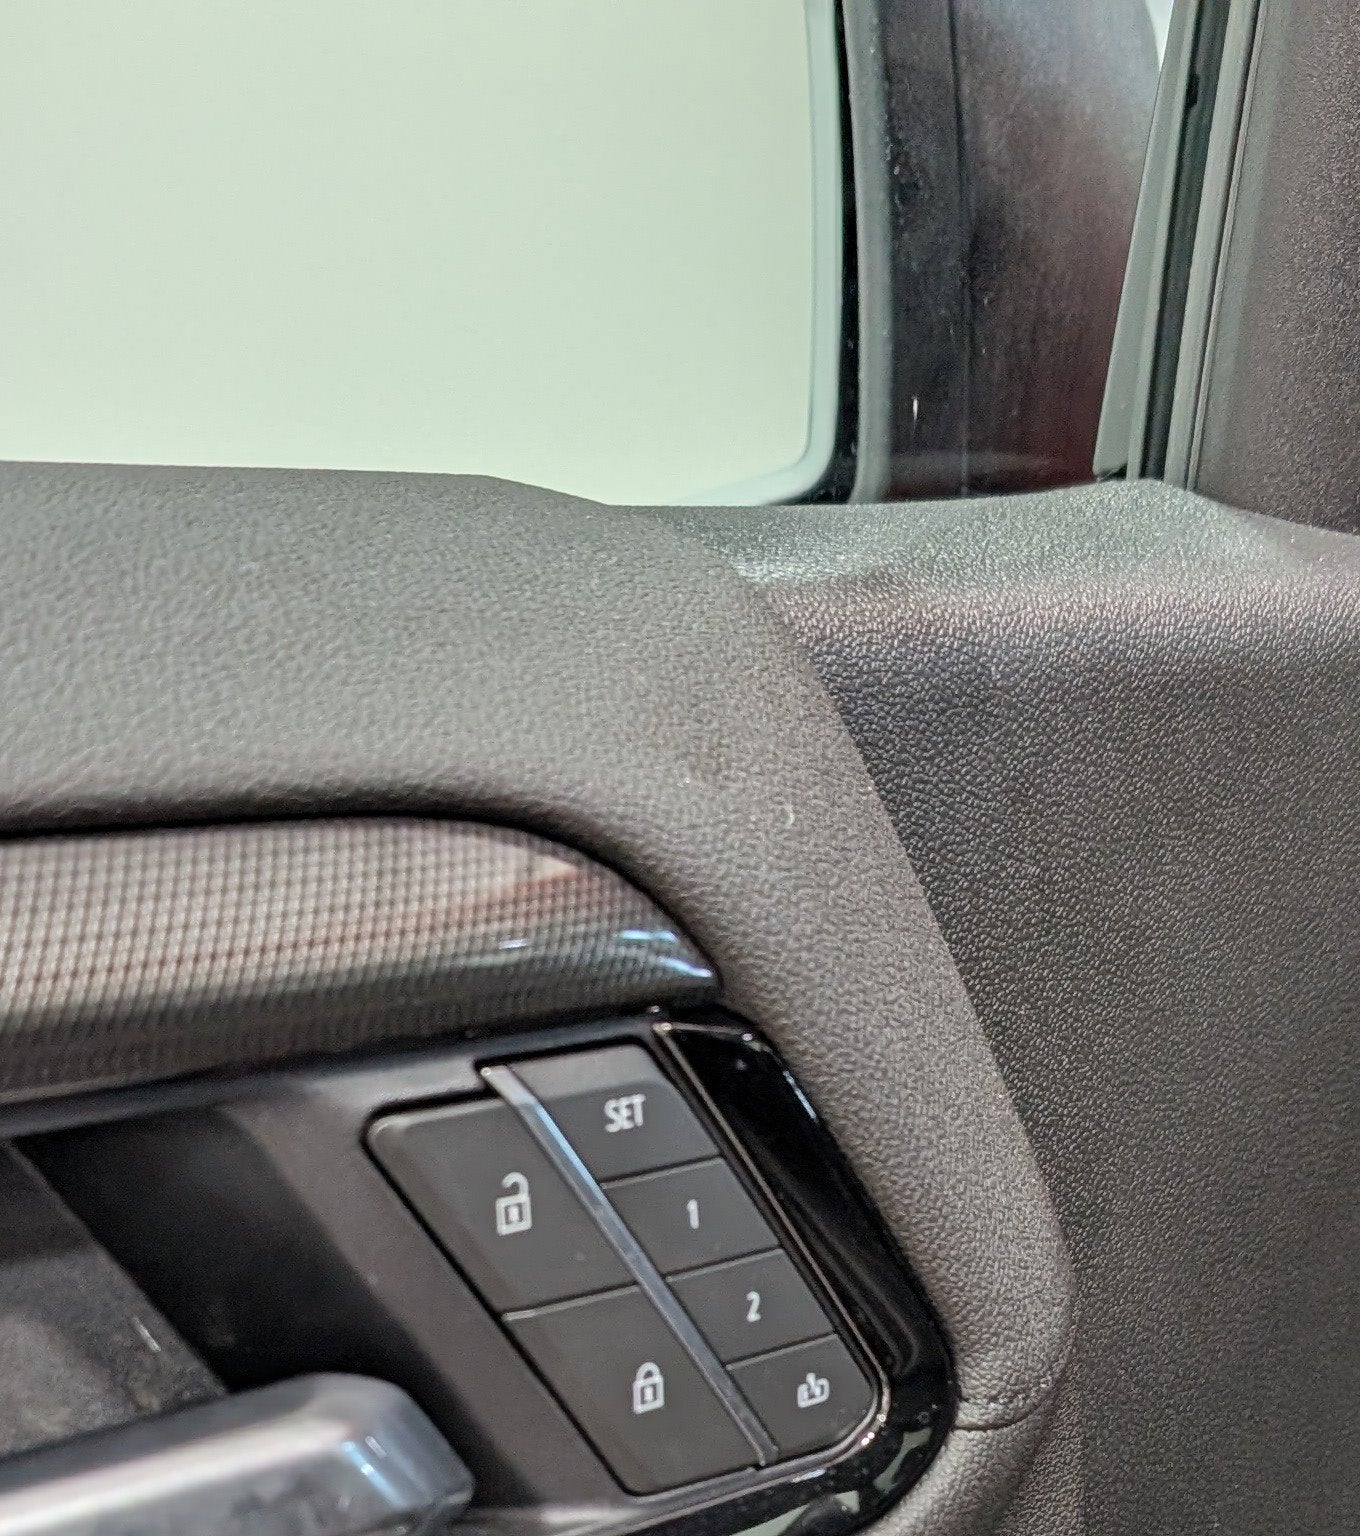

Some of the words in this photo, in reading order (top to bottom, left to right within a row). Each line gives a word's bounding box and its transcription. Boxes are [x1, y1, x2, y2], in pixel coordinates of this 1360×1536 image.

[604, 1094, 646, 1133] SET
[686, 1198, 700, 1230] 1
[745, 1290, 762, 1323] 2
